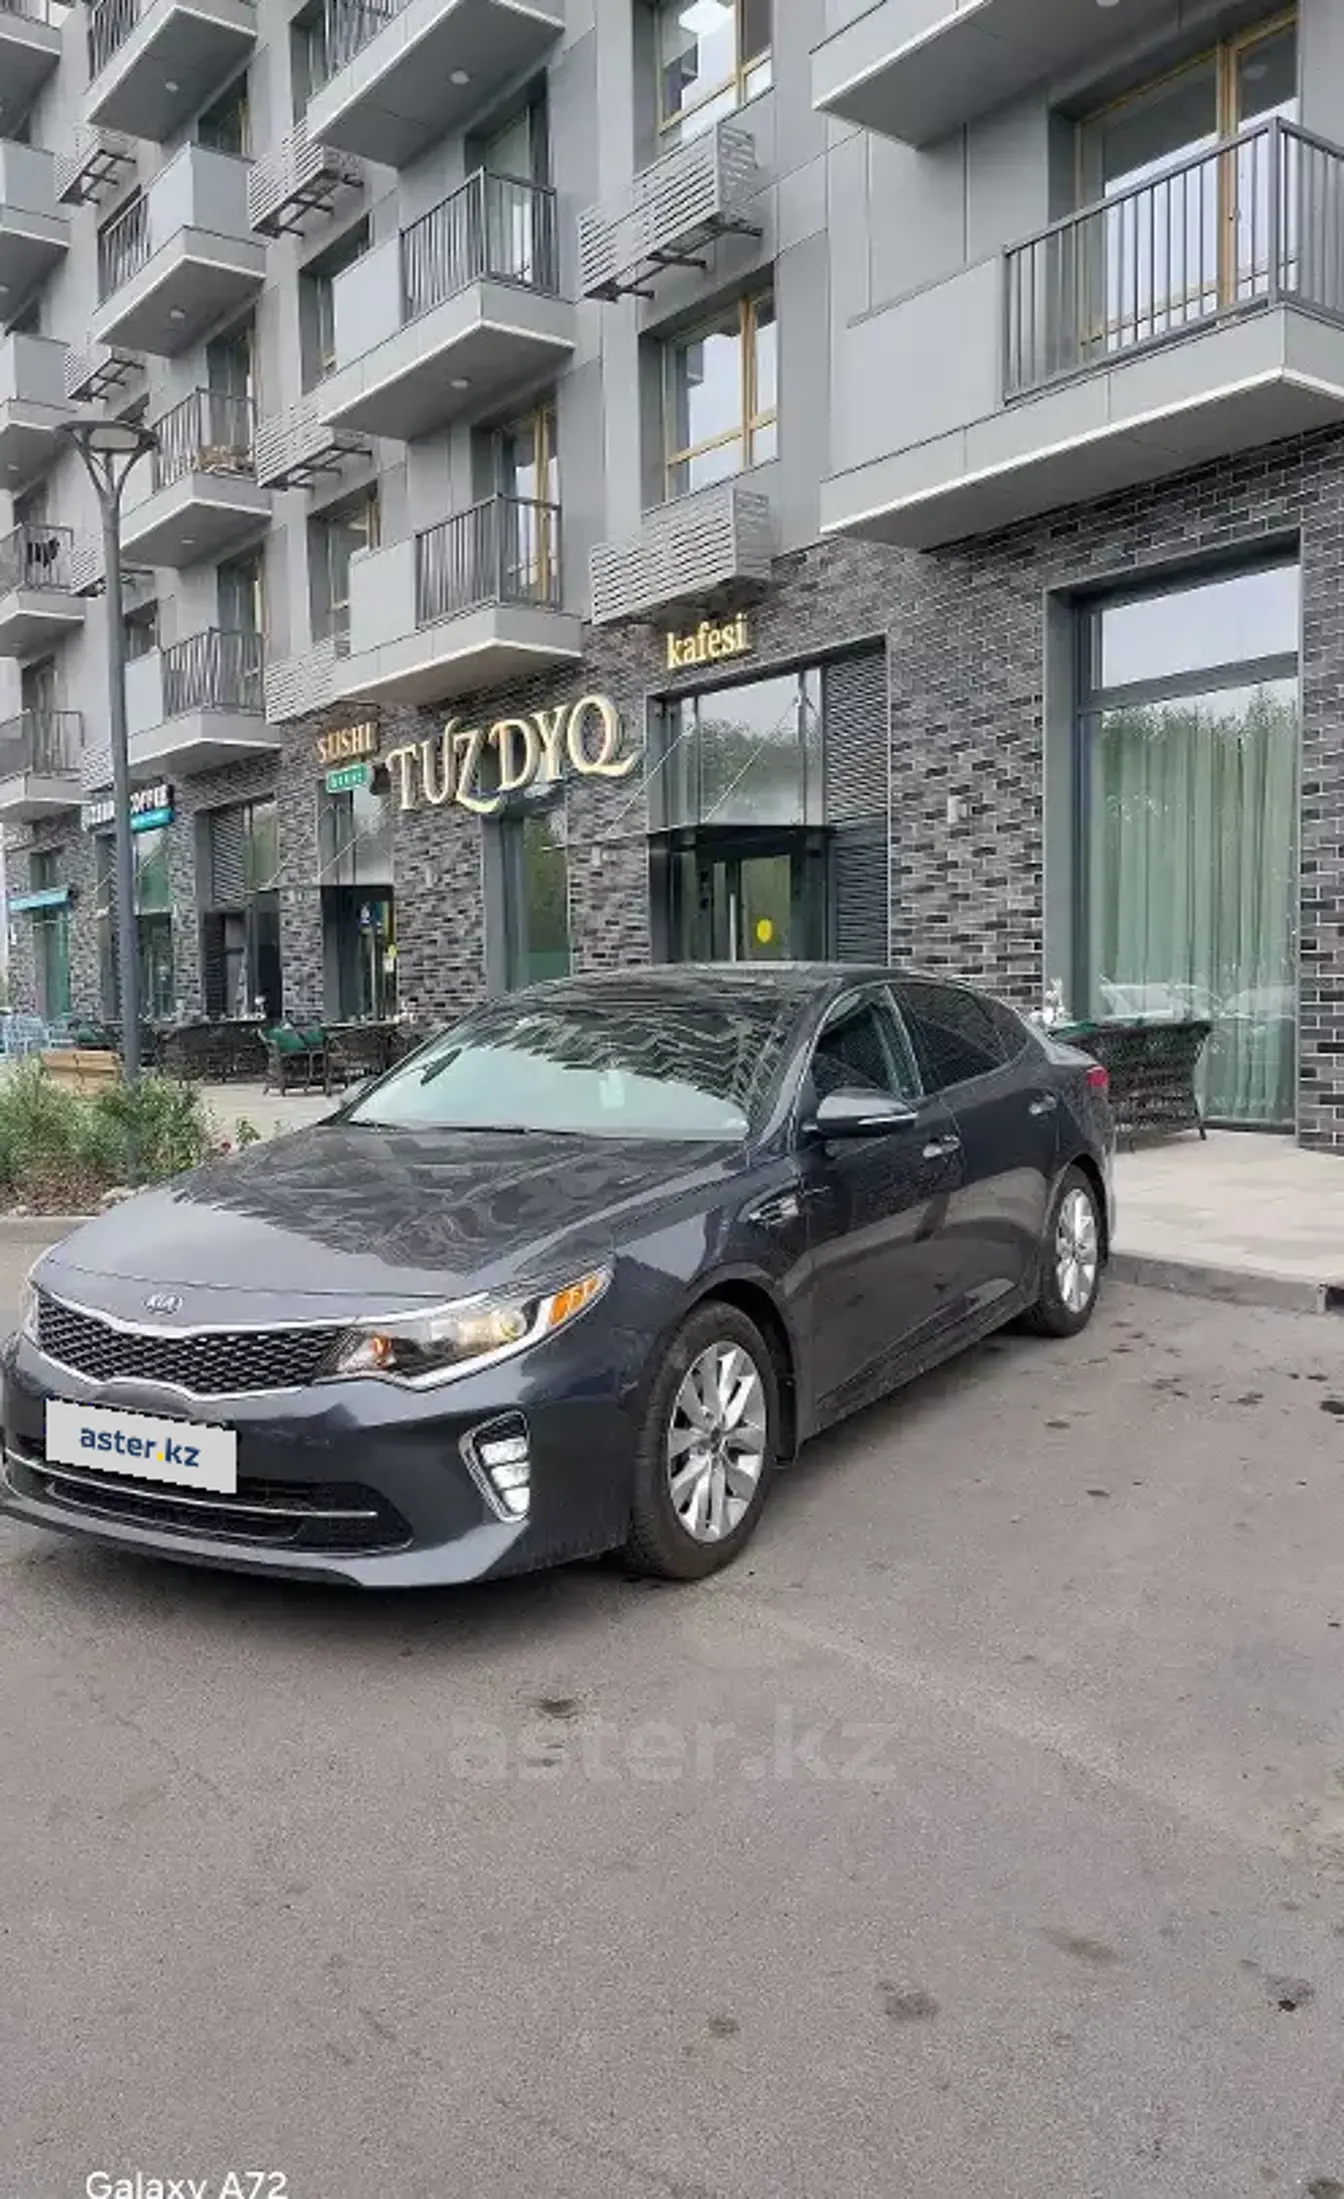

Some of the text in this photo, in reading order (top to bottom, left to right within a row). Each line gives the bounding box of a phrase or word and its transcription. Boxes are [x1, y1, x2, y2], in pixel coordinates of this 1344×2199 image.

[666, 612, 750, 670] kafesi
[317, 722, 377, 763] SUSHI
[385, 695, 643, 813] TUZDYQ
